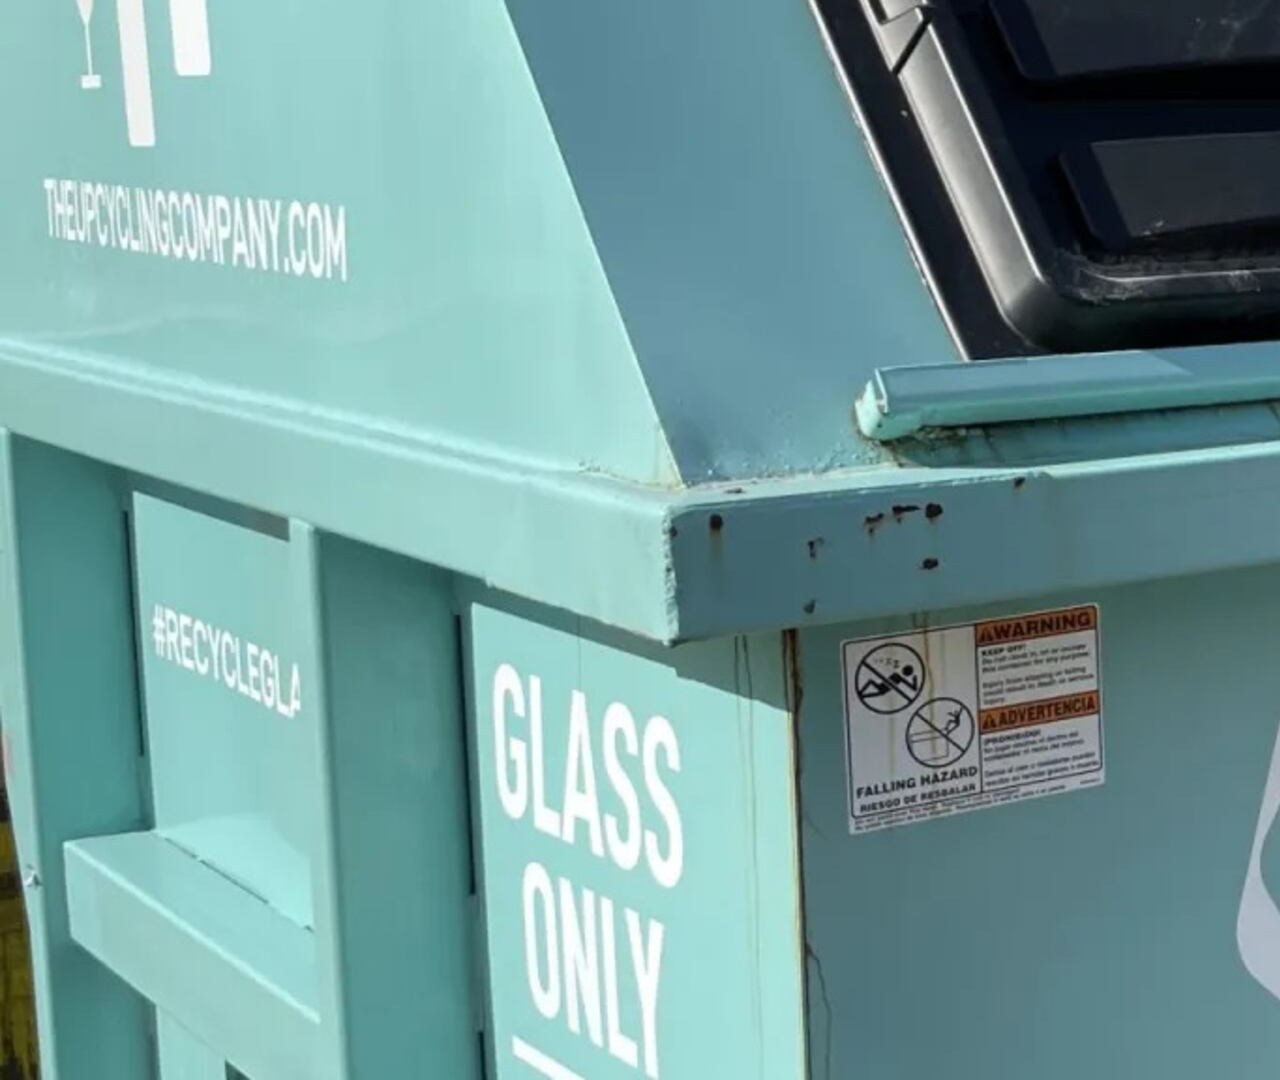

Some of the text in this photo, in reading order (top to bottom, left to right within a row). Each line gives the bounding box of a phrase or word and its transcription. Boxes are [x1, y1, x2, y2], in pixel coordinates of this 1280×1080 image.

[43, 178, 347, 281] THEUPCYCLINGCOMPANY.COM
[994, 612, 1091, 638] WARNING
[1001, 696, 1096, 725] ADVERTENCIA
[493, 663, 683, 888] GLASS
[856, 778, 916, 799] FALLING
[920, 766, 978, 786] HAZARD
[860, 783, 976, 813] RIESGO DE RESBALAR
[522, 862, 664, 1078] ONLY
